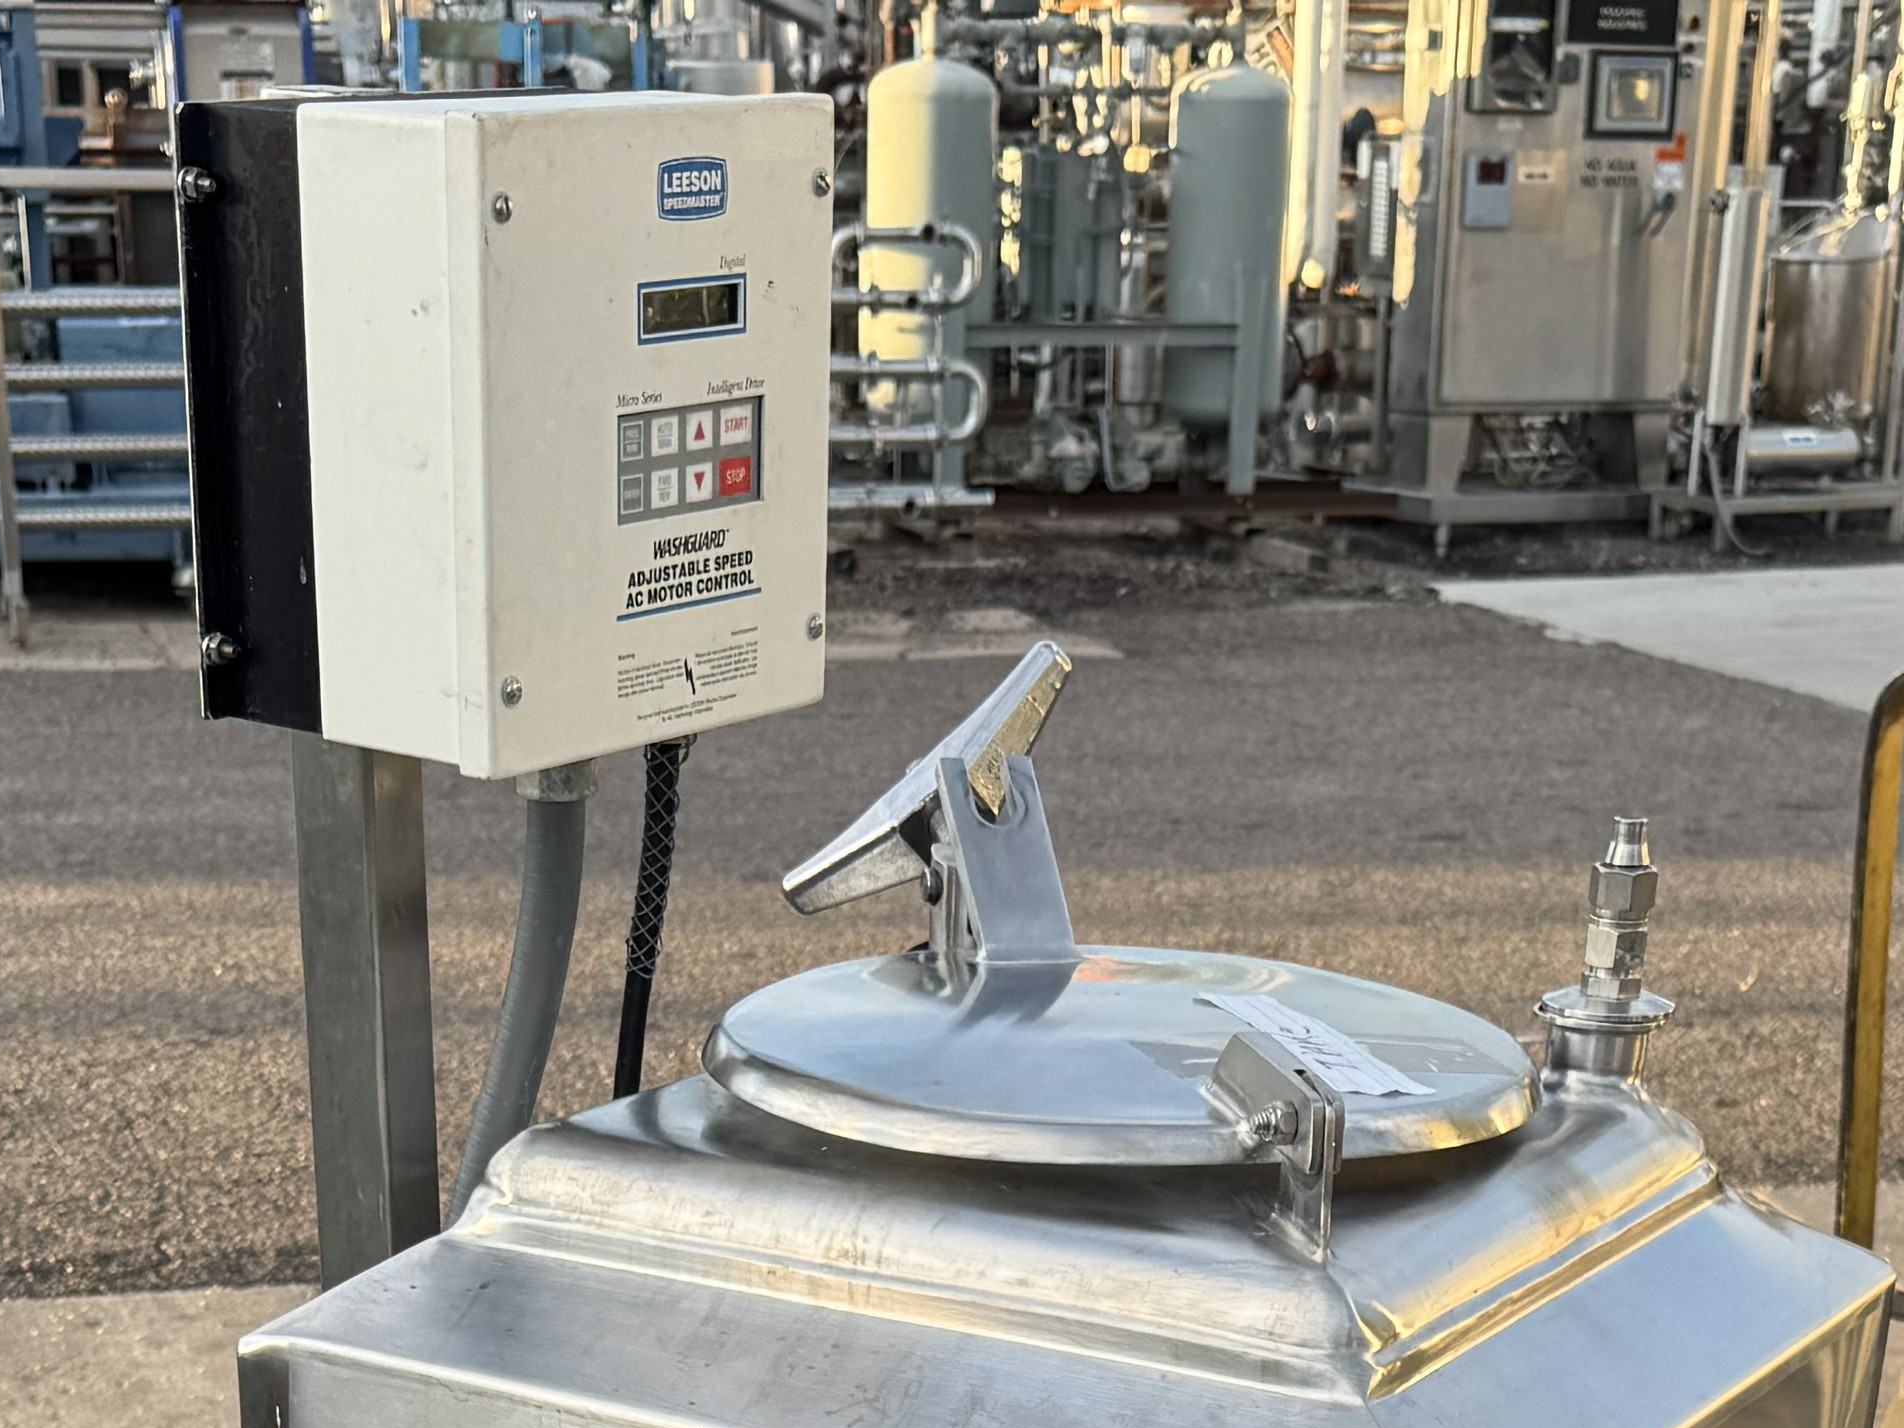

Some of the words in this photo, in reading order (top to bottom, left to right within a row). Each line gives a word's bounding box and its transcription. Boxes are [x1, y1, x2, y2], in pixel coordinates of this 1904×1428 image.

[663, 169, 722, 194] LEESON
[707, 378, 744, 398] Intelligent
[744, 376, 765, 391] Drive
[616, 395, 639, 408] Micro
[641, 391, 663, 405] Series
[724, 416, 749, 434] START
[726, 467, 746, 485] STOP
[627, 558, 711, 589] ADJUSTABLE
[714, 550, 753, 572] SPEED
[626, 591, 644, 609] AC
[647, 581, 693, 605] MOTOR
[696, 569, 755, 596] CONTROL
